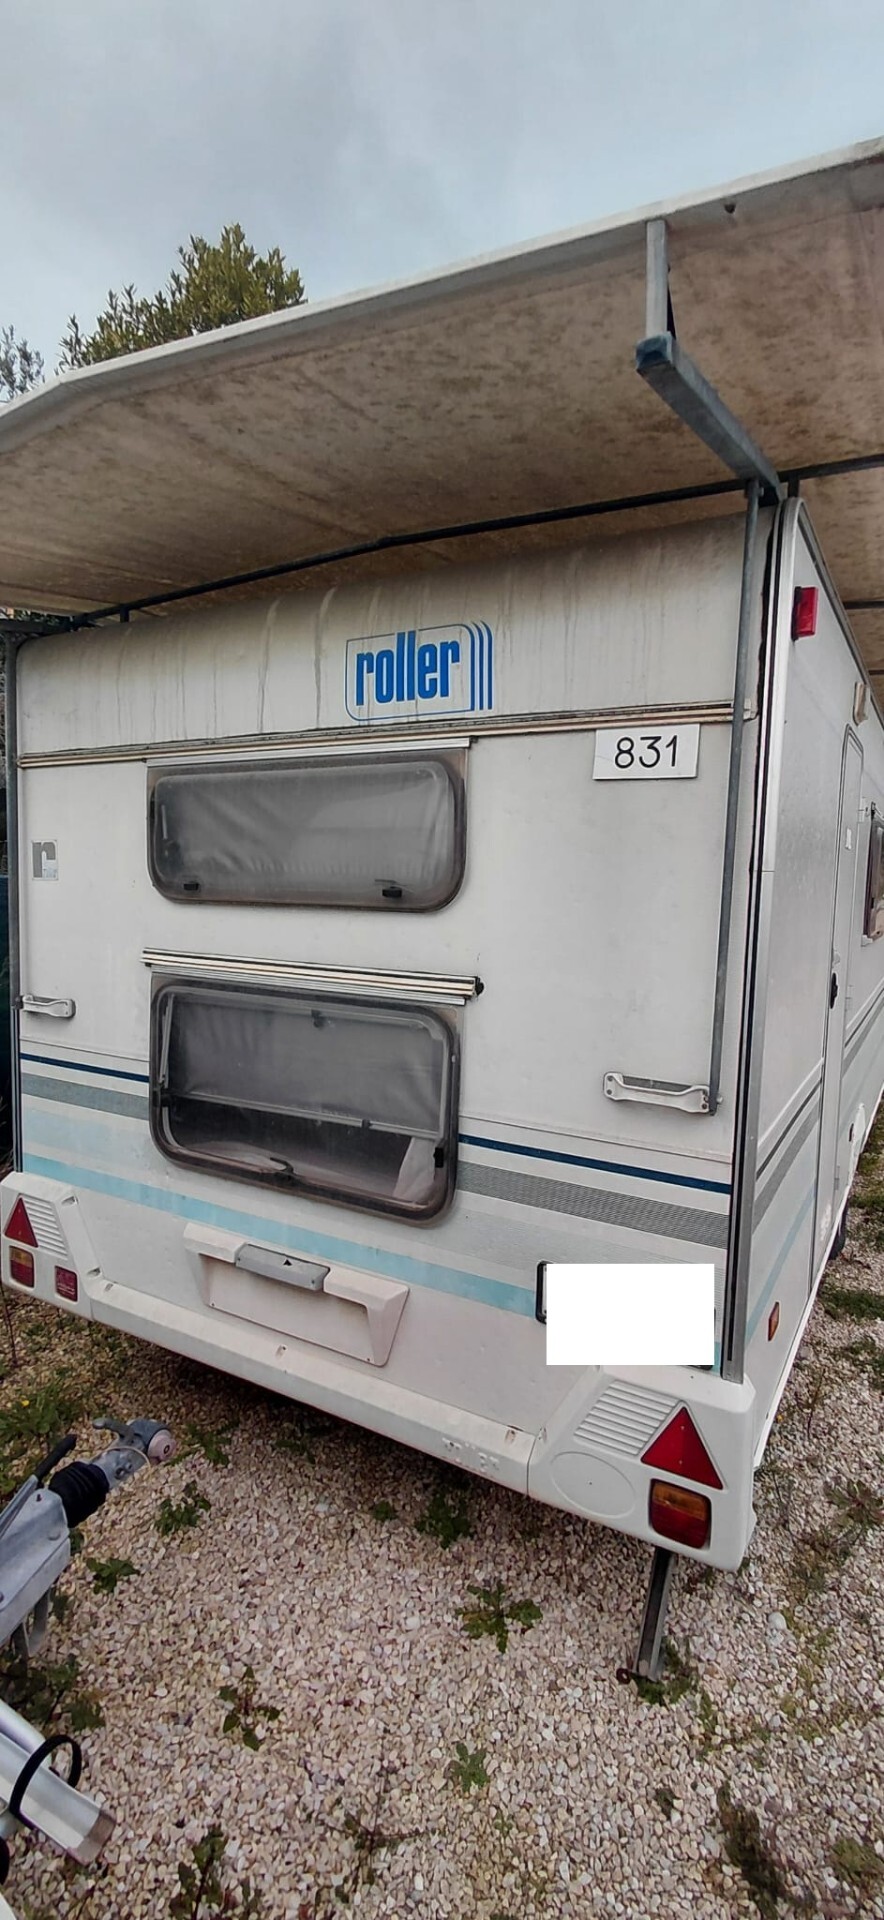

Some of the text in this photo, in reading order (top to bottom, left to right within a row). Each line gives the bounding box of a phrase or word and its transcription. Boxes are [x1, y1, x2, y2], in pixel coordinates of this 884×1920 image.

[355, 631, 460, 706] roller
[614, 735, 679, 768] 831
[32, 842, 56, 878] r
